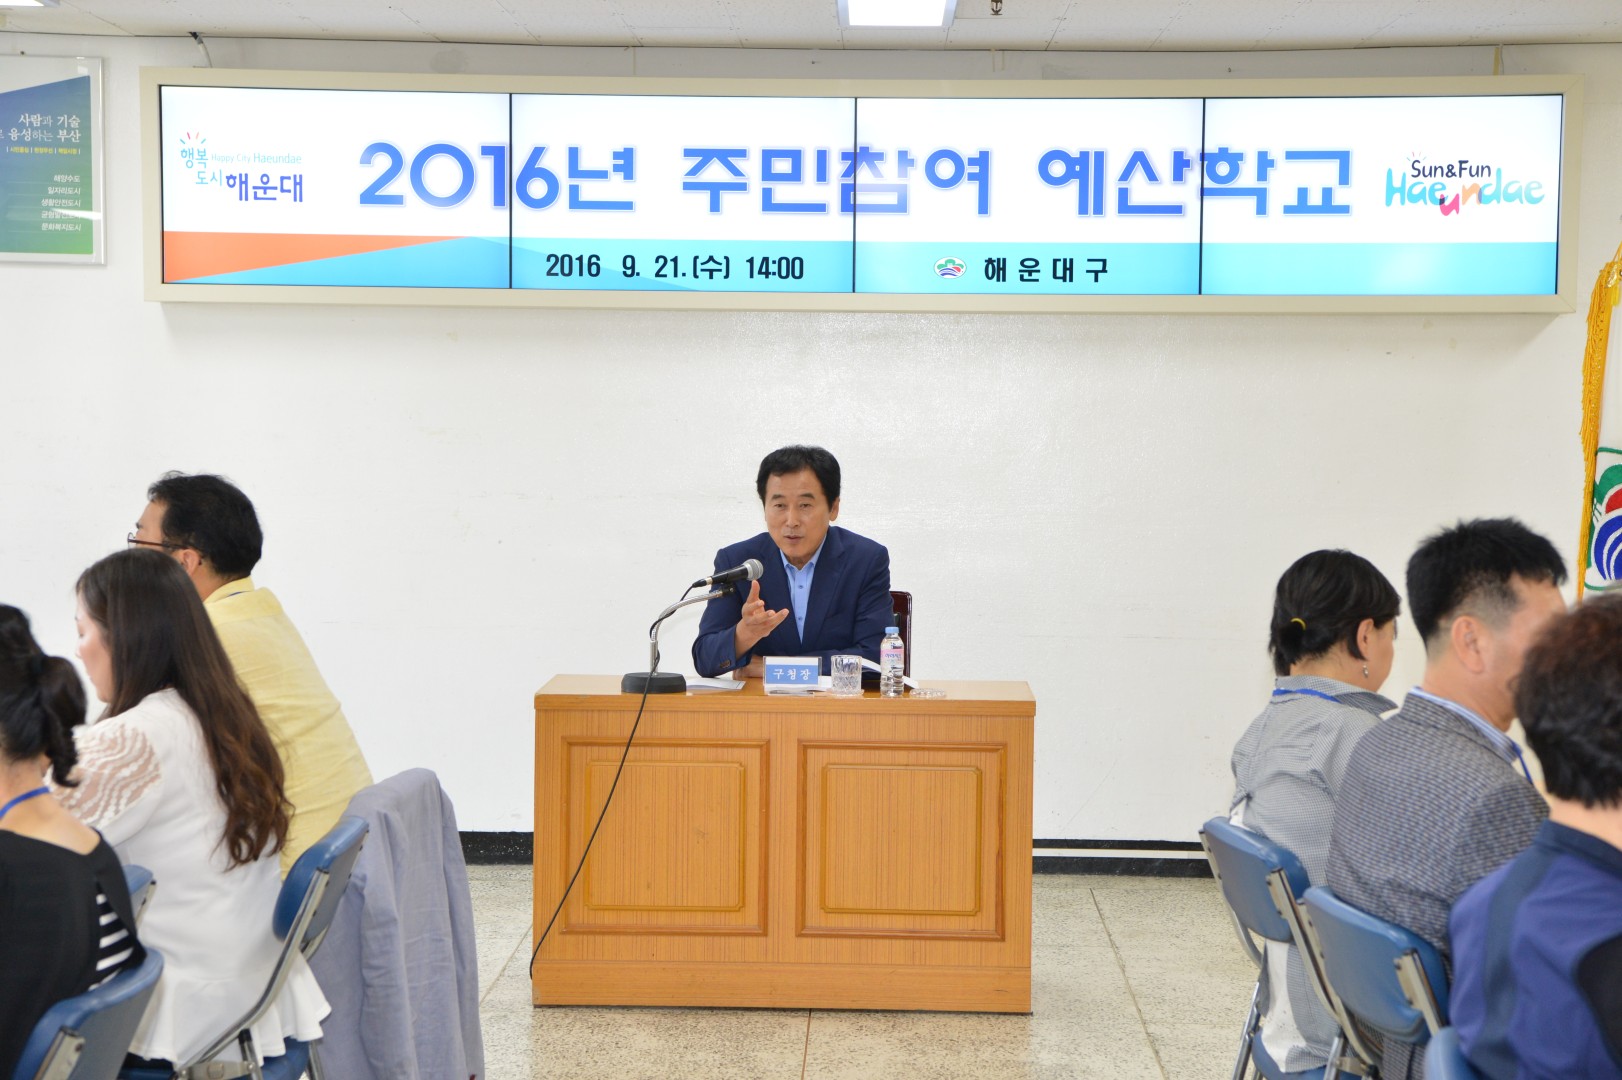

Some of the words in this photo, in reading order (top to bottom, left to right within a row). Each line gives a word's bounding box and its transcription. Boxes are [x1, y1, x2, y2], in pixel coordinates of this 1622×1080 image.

[18, 113, 53, 127] 사람과
[57, 114, 81, 128] 기술
[8, 127, 53, 142] 융성하는
[57, 129, 81, 143] 부산
[180, 147, 209, 169] 행복
[211, 152, 235, 164] Happy
[236, 152, 251, 164] City
[253, 152, 302, 165] Haeundae
[1411, 159, 1491, 179] Sun&Fun
[196, 169, 223, 187] 도시
[226, 173, 303, 202] 해운대
[359, 141, 635, 212] 2016년
[682, 145, 990, 215] 주민참여
[1037, 147, 1351, 216] 예산학교
[1385, 167, 1545, 217] Haeundae
[546, 253, 601, 278] 2016
[622, 254, 641, 278] 9.
[745, 256, 804, 280] 14:00
